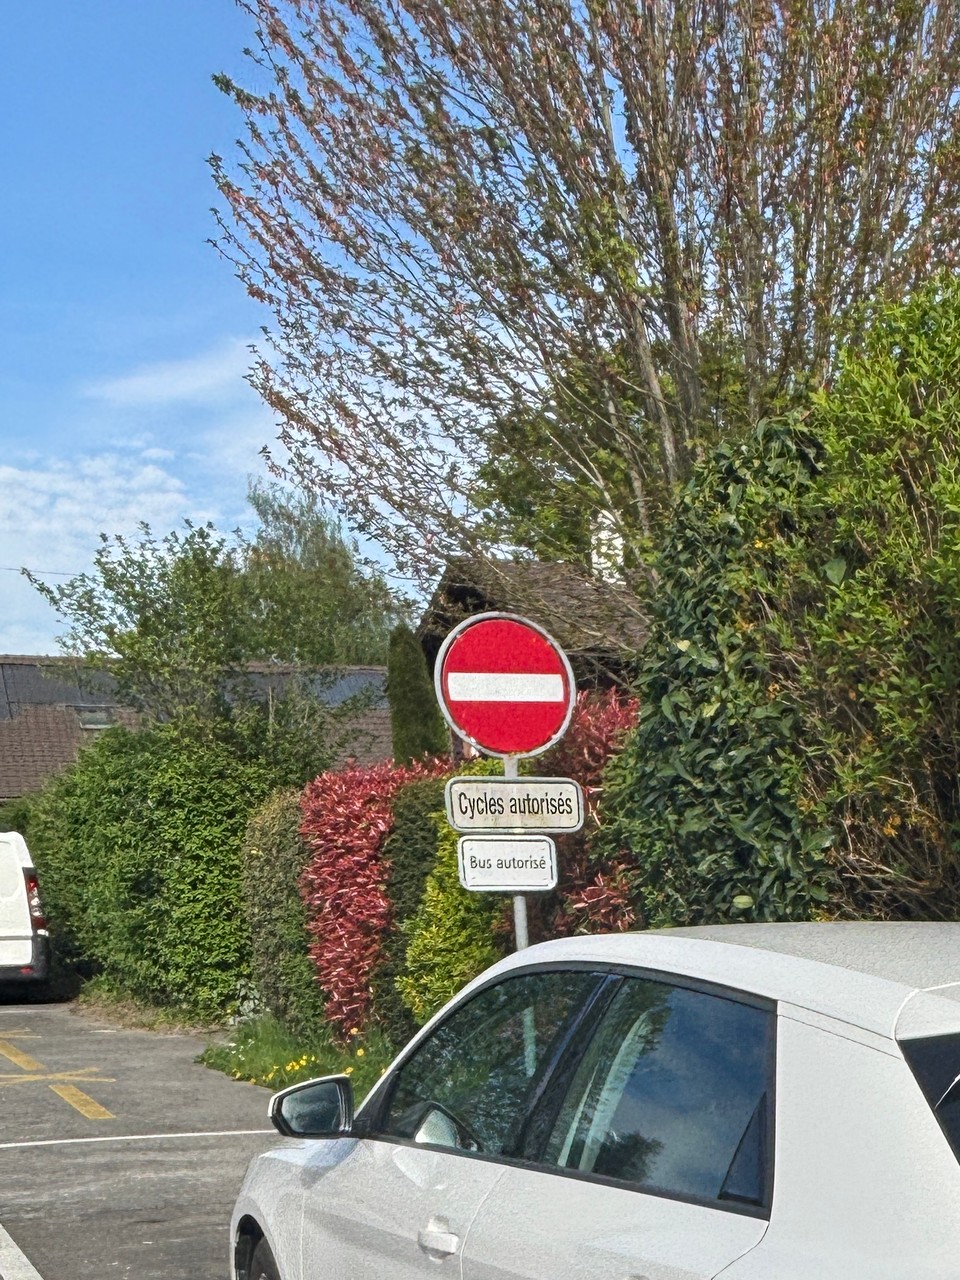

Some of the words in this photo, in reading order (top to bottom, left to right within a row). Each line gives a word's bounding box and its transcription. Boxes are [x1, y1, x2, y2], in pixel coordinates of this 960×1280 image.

[458, 792, 505, 819] Cycles
[509, 792, 573, 815] autorisés
[470, 855, 492, 869] Bus
[496, 855, 546, 869] autorisé
